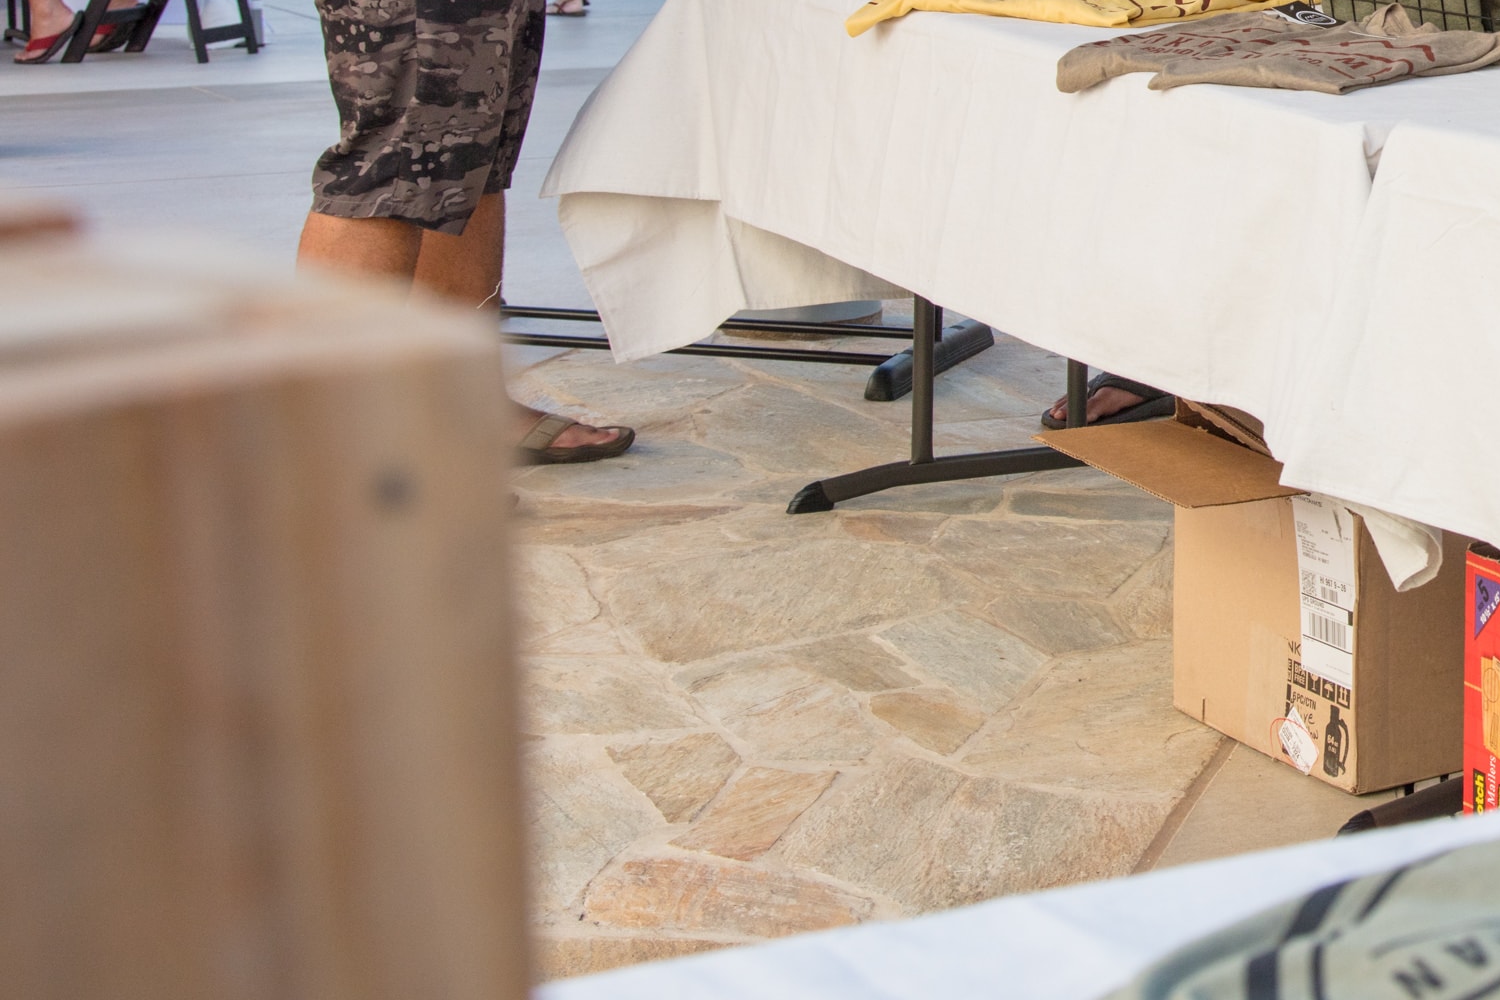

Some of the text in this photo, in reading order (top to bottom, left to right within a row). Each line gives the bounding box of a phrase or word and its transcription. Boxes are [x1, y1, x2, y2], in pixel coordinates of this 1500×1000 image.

[1477, 579, 1489, 603] 5
[1294, 673, 1305, 685] FREE
[1475, 774, 1485, 817] otch
[1487, 755, 1497, 806] Mailers
